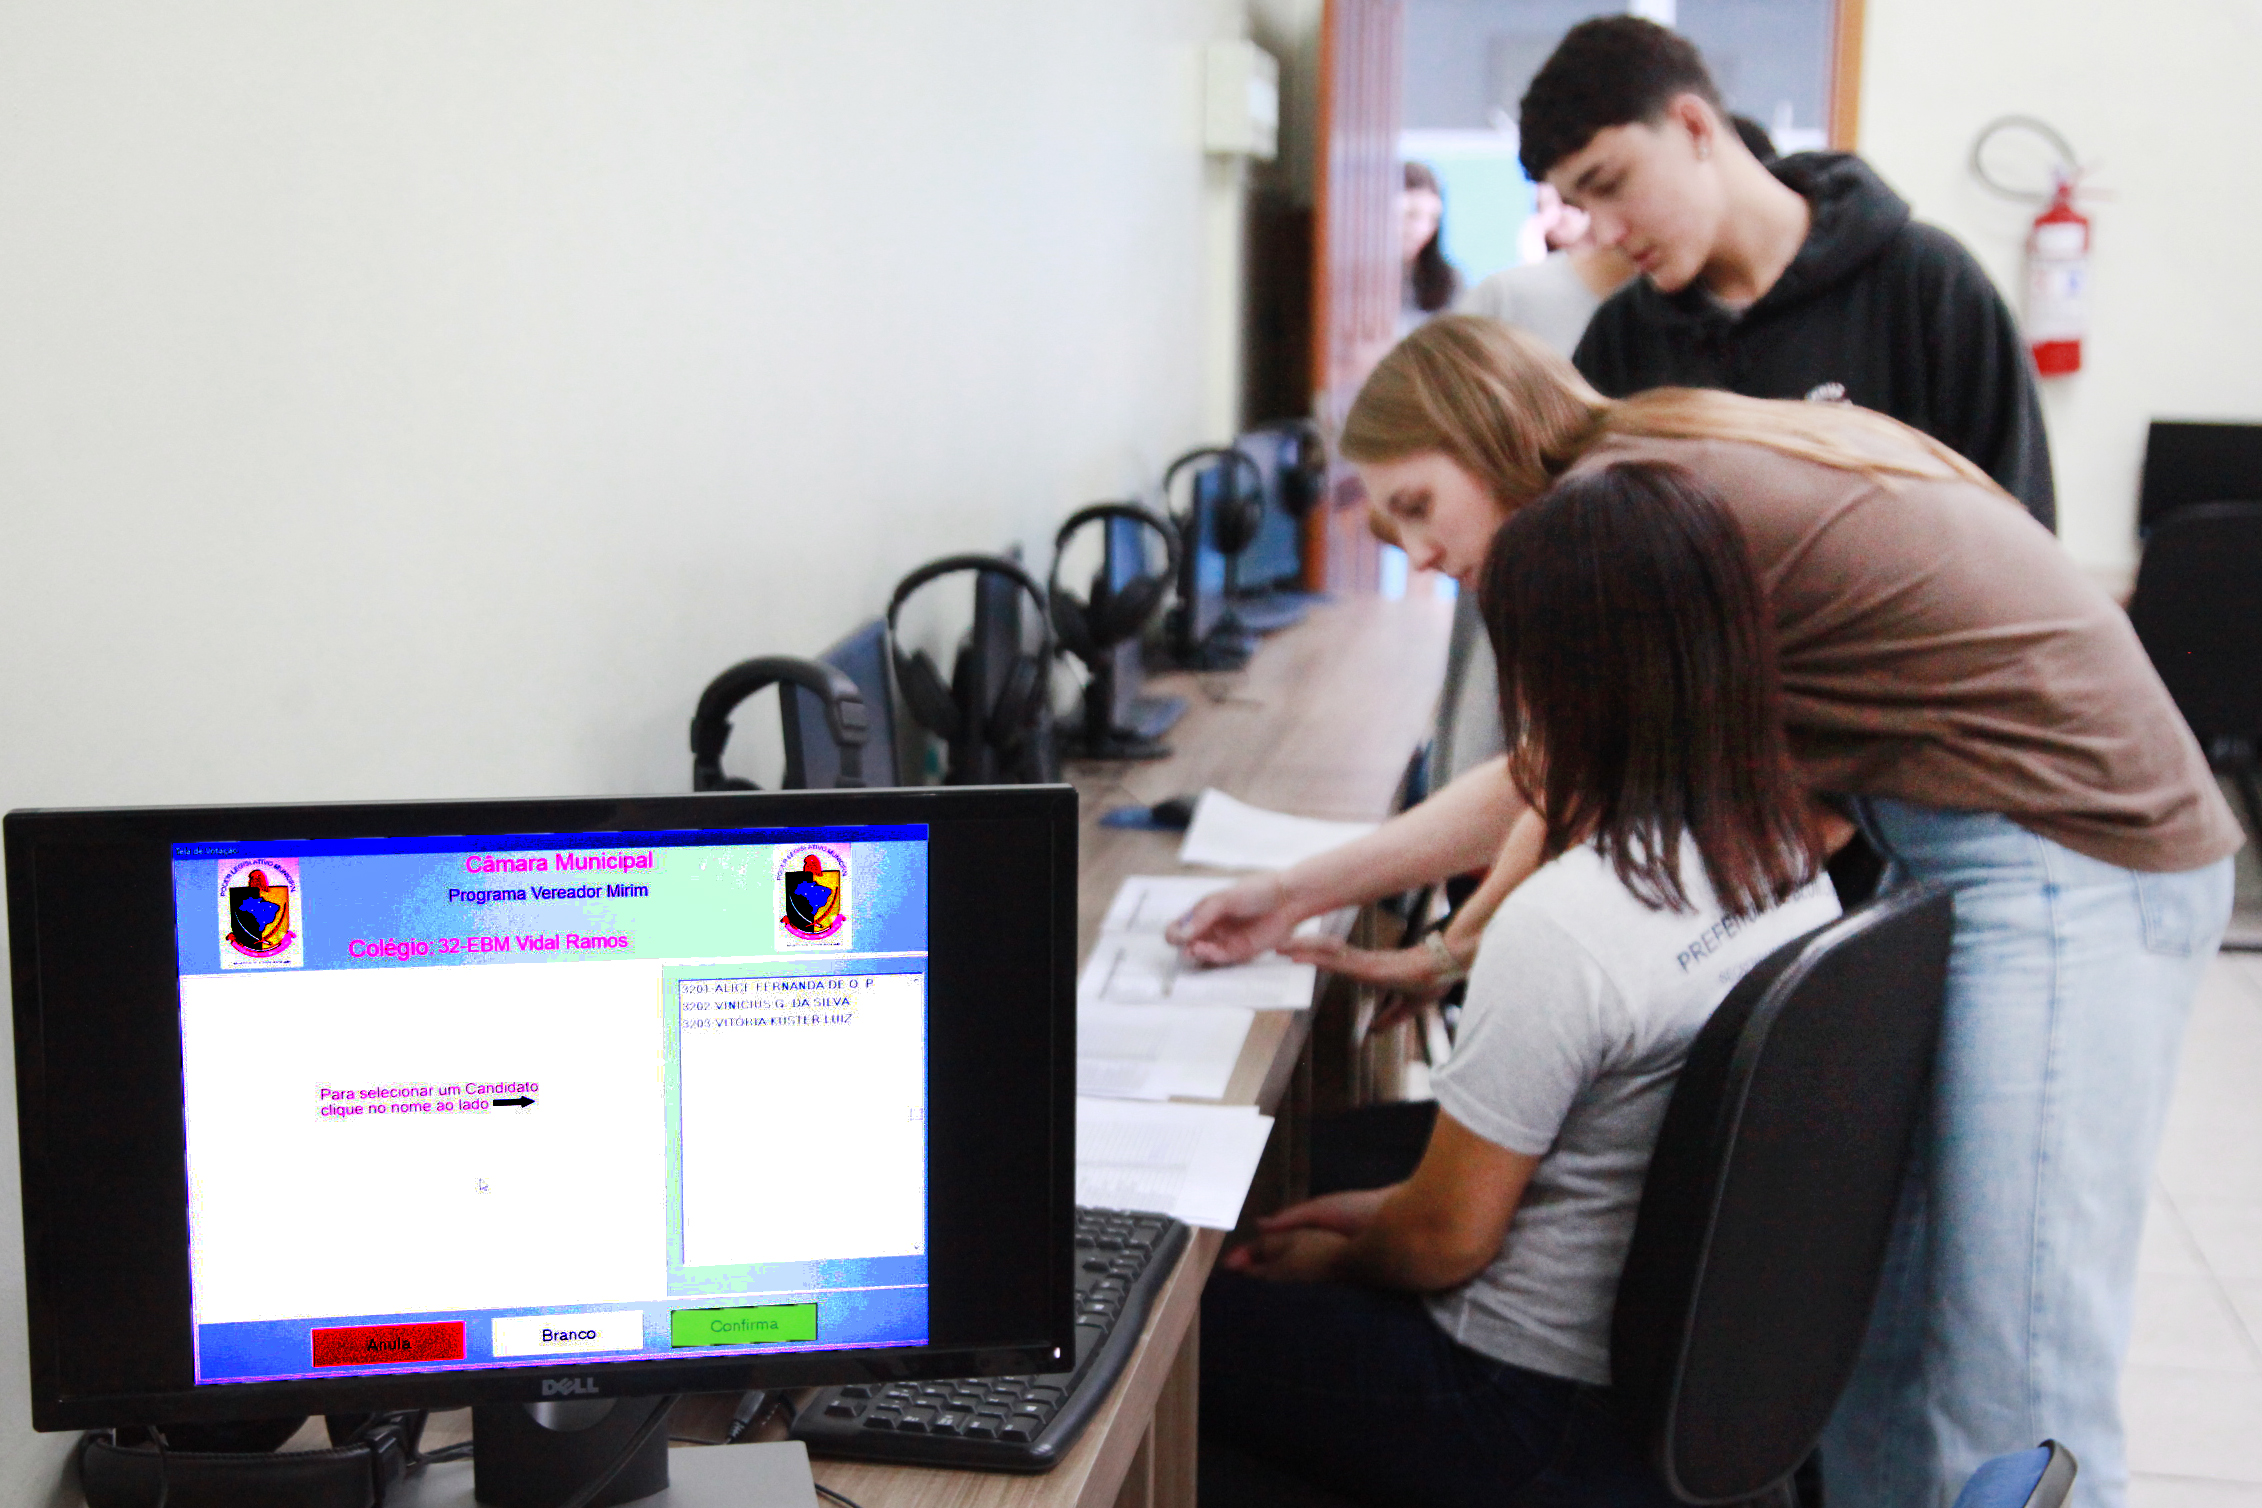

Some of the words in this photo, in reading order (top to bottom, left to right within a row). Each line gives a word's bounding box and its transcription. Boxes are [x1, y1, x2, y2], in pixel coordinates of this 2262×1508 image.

[465, 854, 549, 874] Câmara
[555, 850, 654, 874] Municipal
[448, 886, 527, 905] Programa
[530, 885, 602, 900] Vereador
[606, 883, 649, 899] Mirim
[348, 938, 435, 962] Colégio:
[438, 935, 511, 955] 32-EBM
[515, 933, 560, 952] Vidal
[565, 932, 629, 950] Ramos
[756, 981, 825, 992] FERNANDA
[828, 979, 844, 990] DE
[715, 999, 771, 1010] VINICIUS
[792, 998, 810, 1008] DA
[813, 996, 851, 1007] SILVA
[320, 1088, 355, 1101] Para
[358, 1086, 434, 1100] selecionar
[438, 1084, 461, 1097] um
[465, 1081, 539, 1096] Candidato
[320, 1102, 364, 1118] clique
[368, 1102, 387, 1115] no
[390, 1101, 432, 1114] nome
[436, 1100, 454, 1112] ao
[458, 1098, 490, 1111] lado
[541, 1328, 597, 1343] Branco
[710, 1318, 779, 1334] Confirma
[367, 1336, 413, 1352] Anula
[541, 1377, 600, 1396] DELL
